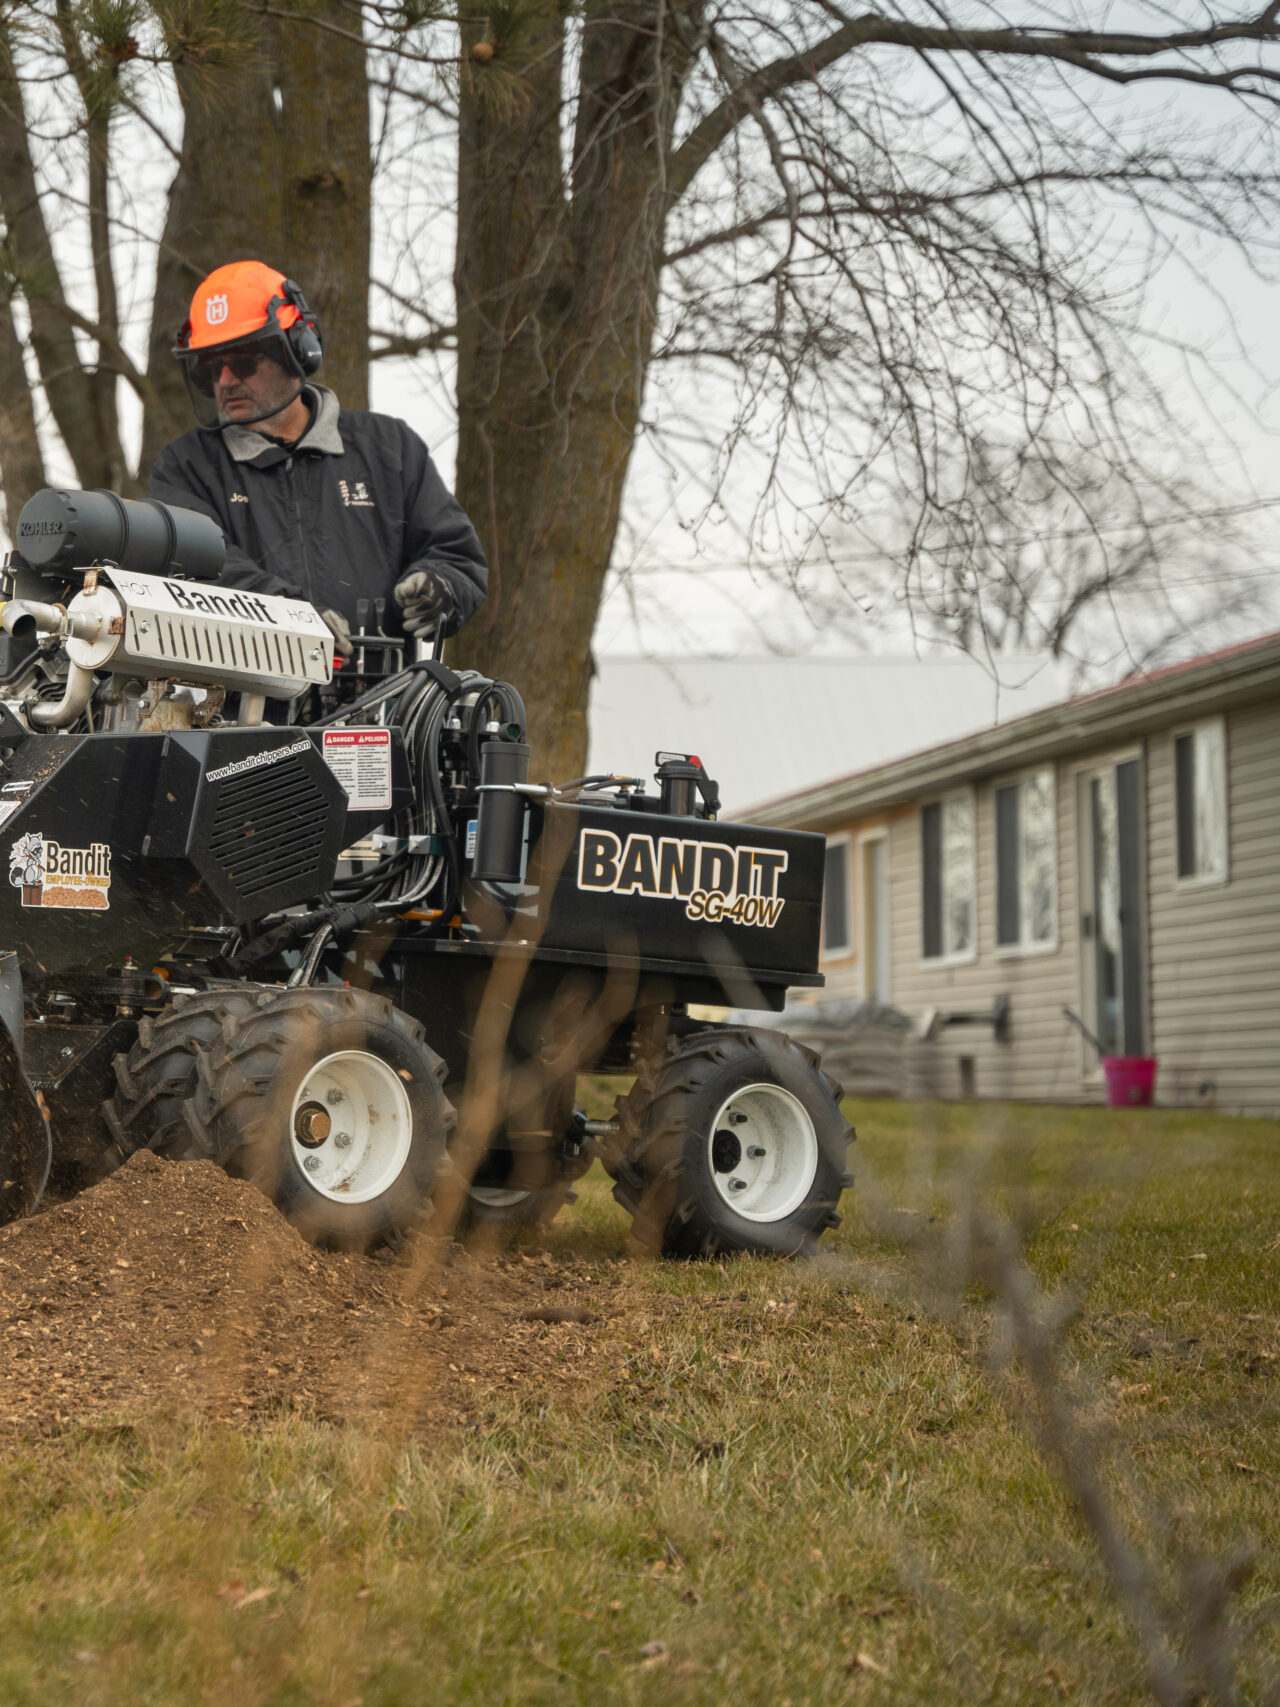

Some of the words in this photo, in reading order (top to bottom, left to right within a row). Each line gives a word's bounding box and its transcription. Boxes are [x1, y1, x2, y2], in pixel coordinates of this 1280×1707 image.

[21, 521, 63, 537] KOHLER
[118, 579, 152, 597] HOT
[162, 581, 278, 625] Bandit
[286, 608, 319, 625] HOT
[206, 740, 311, 781] www.banditchippers.com
[46, 842, 110, 877] Bandit
[578, 829, 787, 900] BANDIT
[46, 873, 110, 888] EMPLOYEE-OWNED
[686, 890, 785, 928] SG-40W
